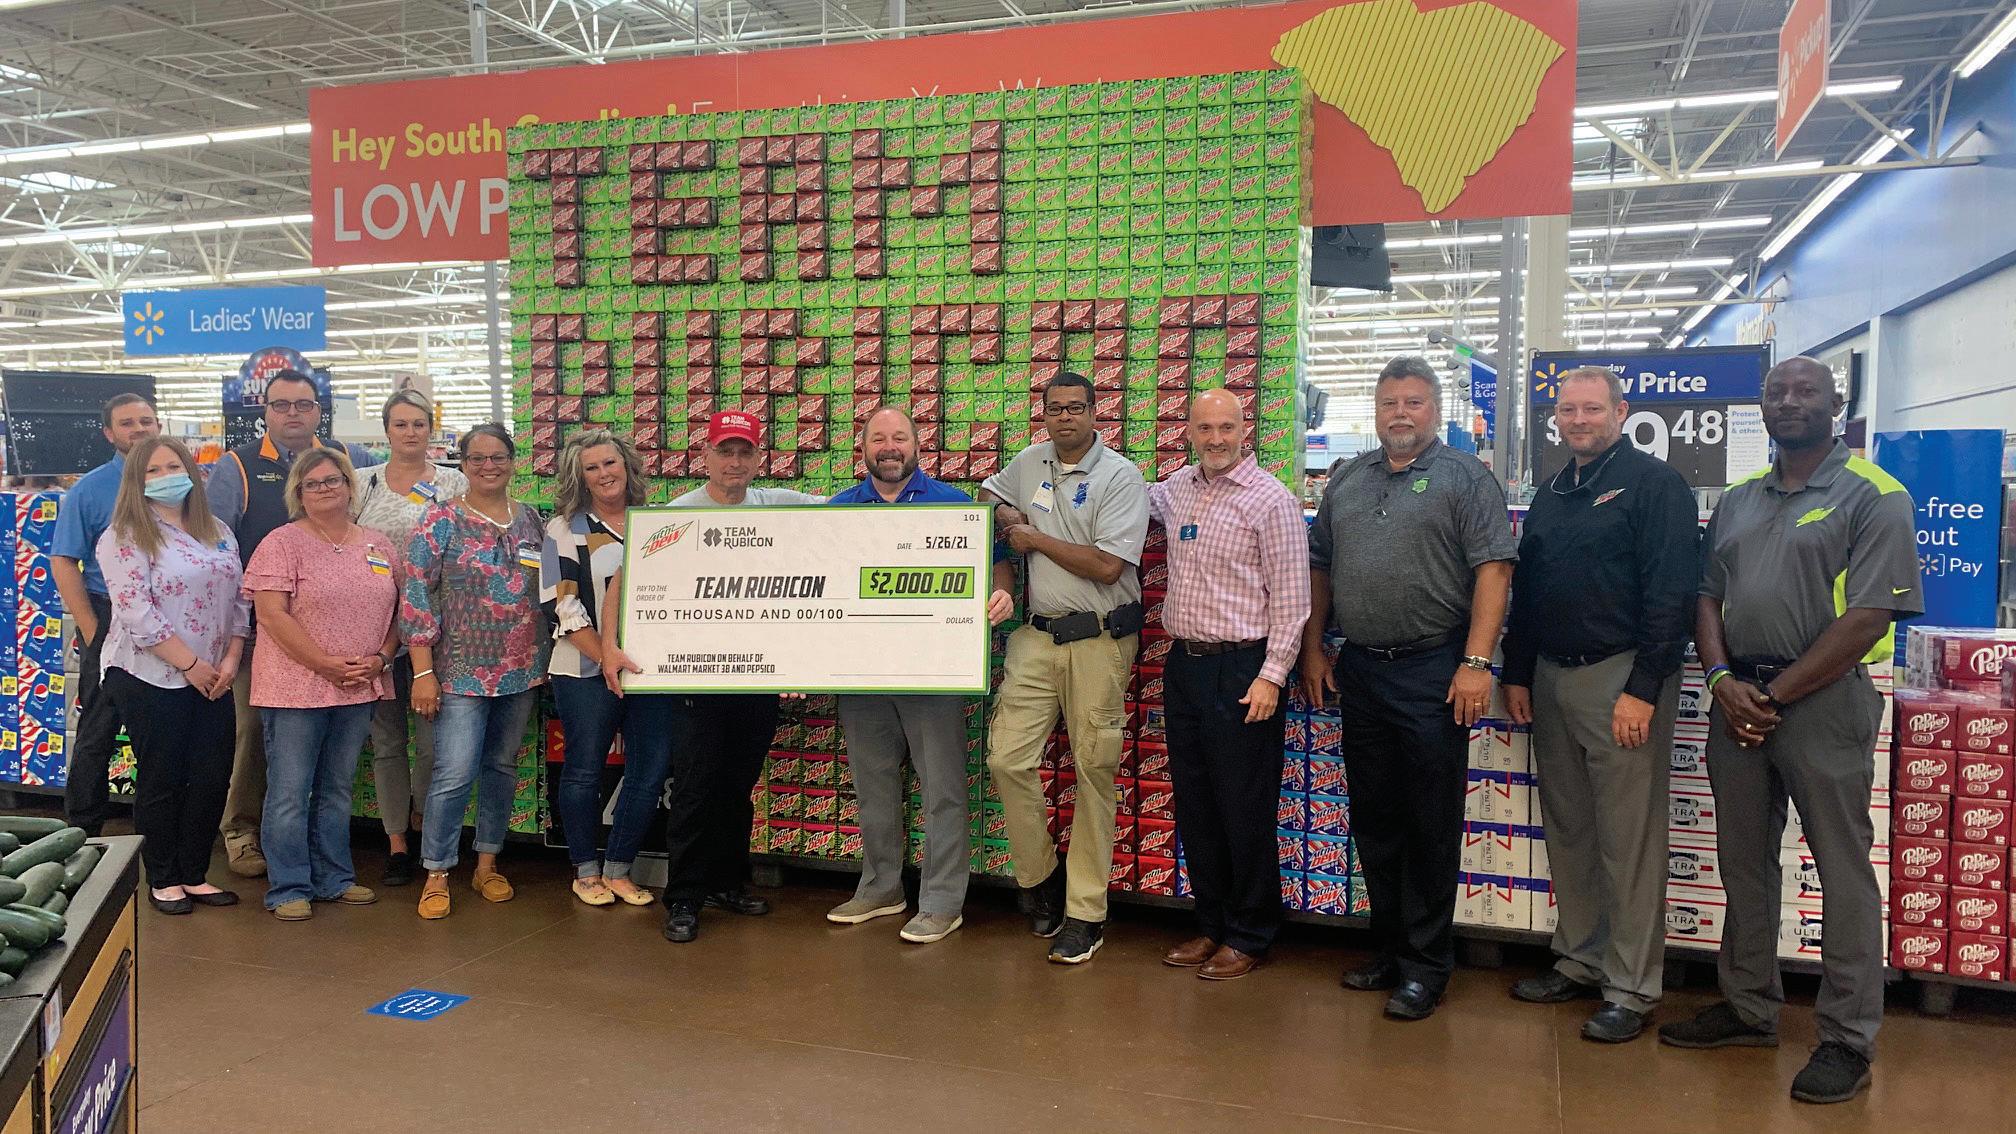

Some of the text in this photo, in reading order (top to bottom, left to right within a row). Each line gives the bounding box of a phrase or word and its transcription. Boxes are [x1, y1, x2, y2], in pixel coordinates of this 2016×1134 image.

[332, 117, 502, 171] Hey South
[334, 179, 466, 242] LOW
[261, 306, 314, 331] Wear
[1474, 381, 1497, 390] Scan
[1639, 370, 1708, 393] Price
[1671, 409, 1724, 445] 48
[963, 514, 980, 522] 101
[724, 527, 756, 536] TEAM
[723, 537, 773, 549] RUBICON
[925, 536, 968, 549] 5/26/21
[1950, 558, 1983, 578] Pay
[694, 575, 826, 599] TEAM RUBICON
[636, 608, 844, 620] TWO THOUSAND AND 00/100
[667, 653, 764, 663] TEAM RUBICON ON BEHALF OF
[657, 665, 776, 673] WALMART MARKET 3B AND PEPSICO
[1910, 714, 1946, 731] Pepper
[1923, 712, 1938, 721] Dr
[1980, 718, 1995, 726] Dr
[1967, 720, 2004, 736] Pepper
[1483, 737, 1491, 760] ULTRA
[1907, 761, 1944, 778] Pepper
[1921, 759, 1936, 768] Dr
[1976, 763, 1991, 772] Dr
[1962, 765, 1999, 781] Pepper
[1903, 804, 1940, 820] Pepper
[1916, 802, 1931, 810] Dr
[1977, 809, 1992, 817] Dr
[1963, 811, 2000, 827] Pepper
[1902, 849, 1939, 865] Pepper
[1916, 847, 1930, 855] Dr
[1974, 853, 1988, 862] Dr
[1960, 855, 1997, 872] Pepper
[1902, 894, 1938, 910] Pepper
[1915, 892, 1930, 900] Dr
[1970, 898, 1985, 907] Dr
[1957, 900, 1994, 917] Pepper
[1902, 938, 1939, 955] Pepper
[1916, 936, 1930, 945] Dr
[1973, 944, 1988, 952] Dr
[1959, 946, 1996, 962] Pepper
[94, 1058, 116, 1133] Price
